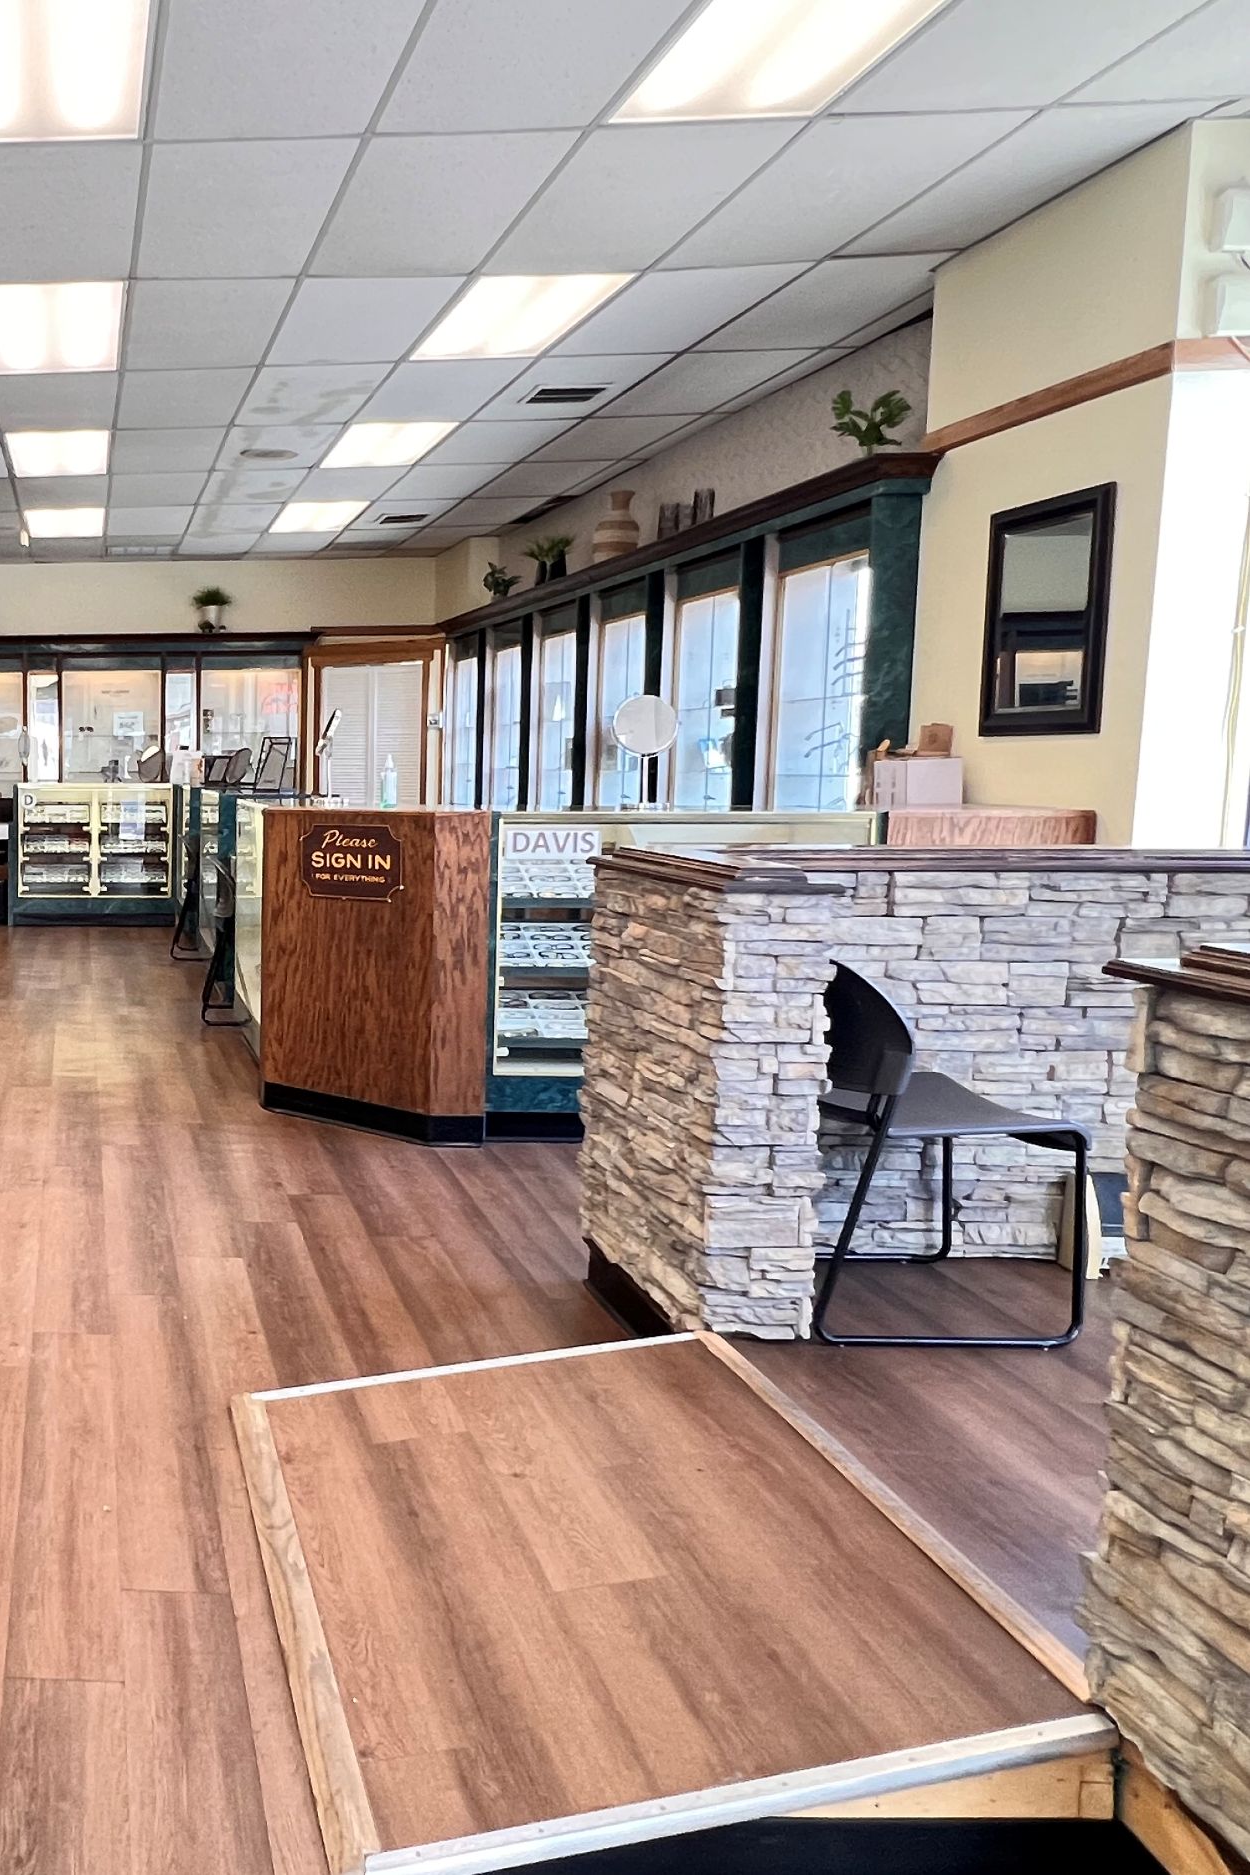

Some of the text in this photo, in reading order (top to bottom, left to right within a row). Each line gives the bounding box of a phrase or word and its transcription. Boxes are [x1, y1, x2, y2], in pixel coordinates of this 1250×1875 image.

[24, 794, 34, 806] D
[321, 829, 379, 849] Please
[512, 831, 596, 854] DAVIS
[311, 850, 391, 870] SIGN IN
